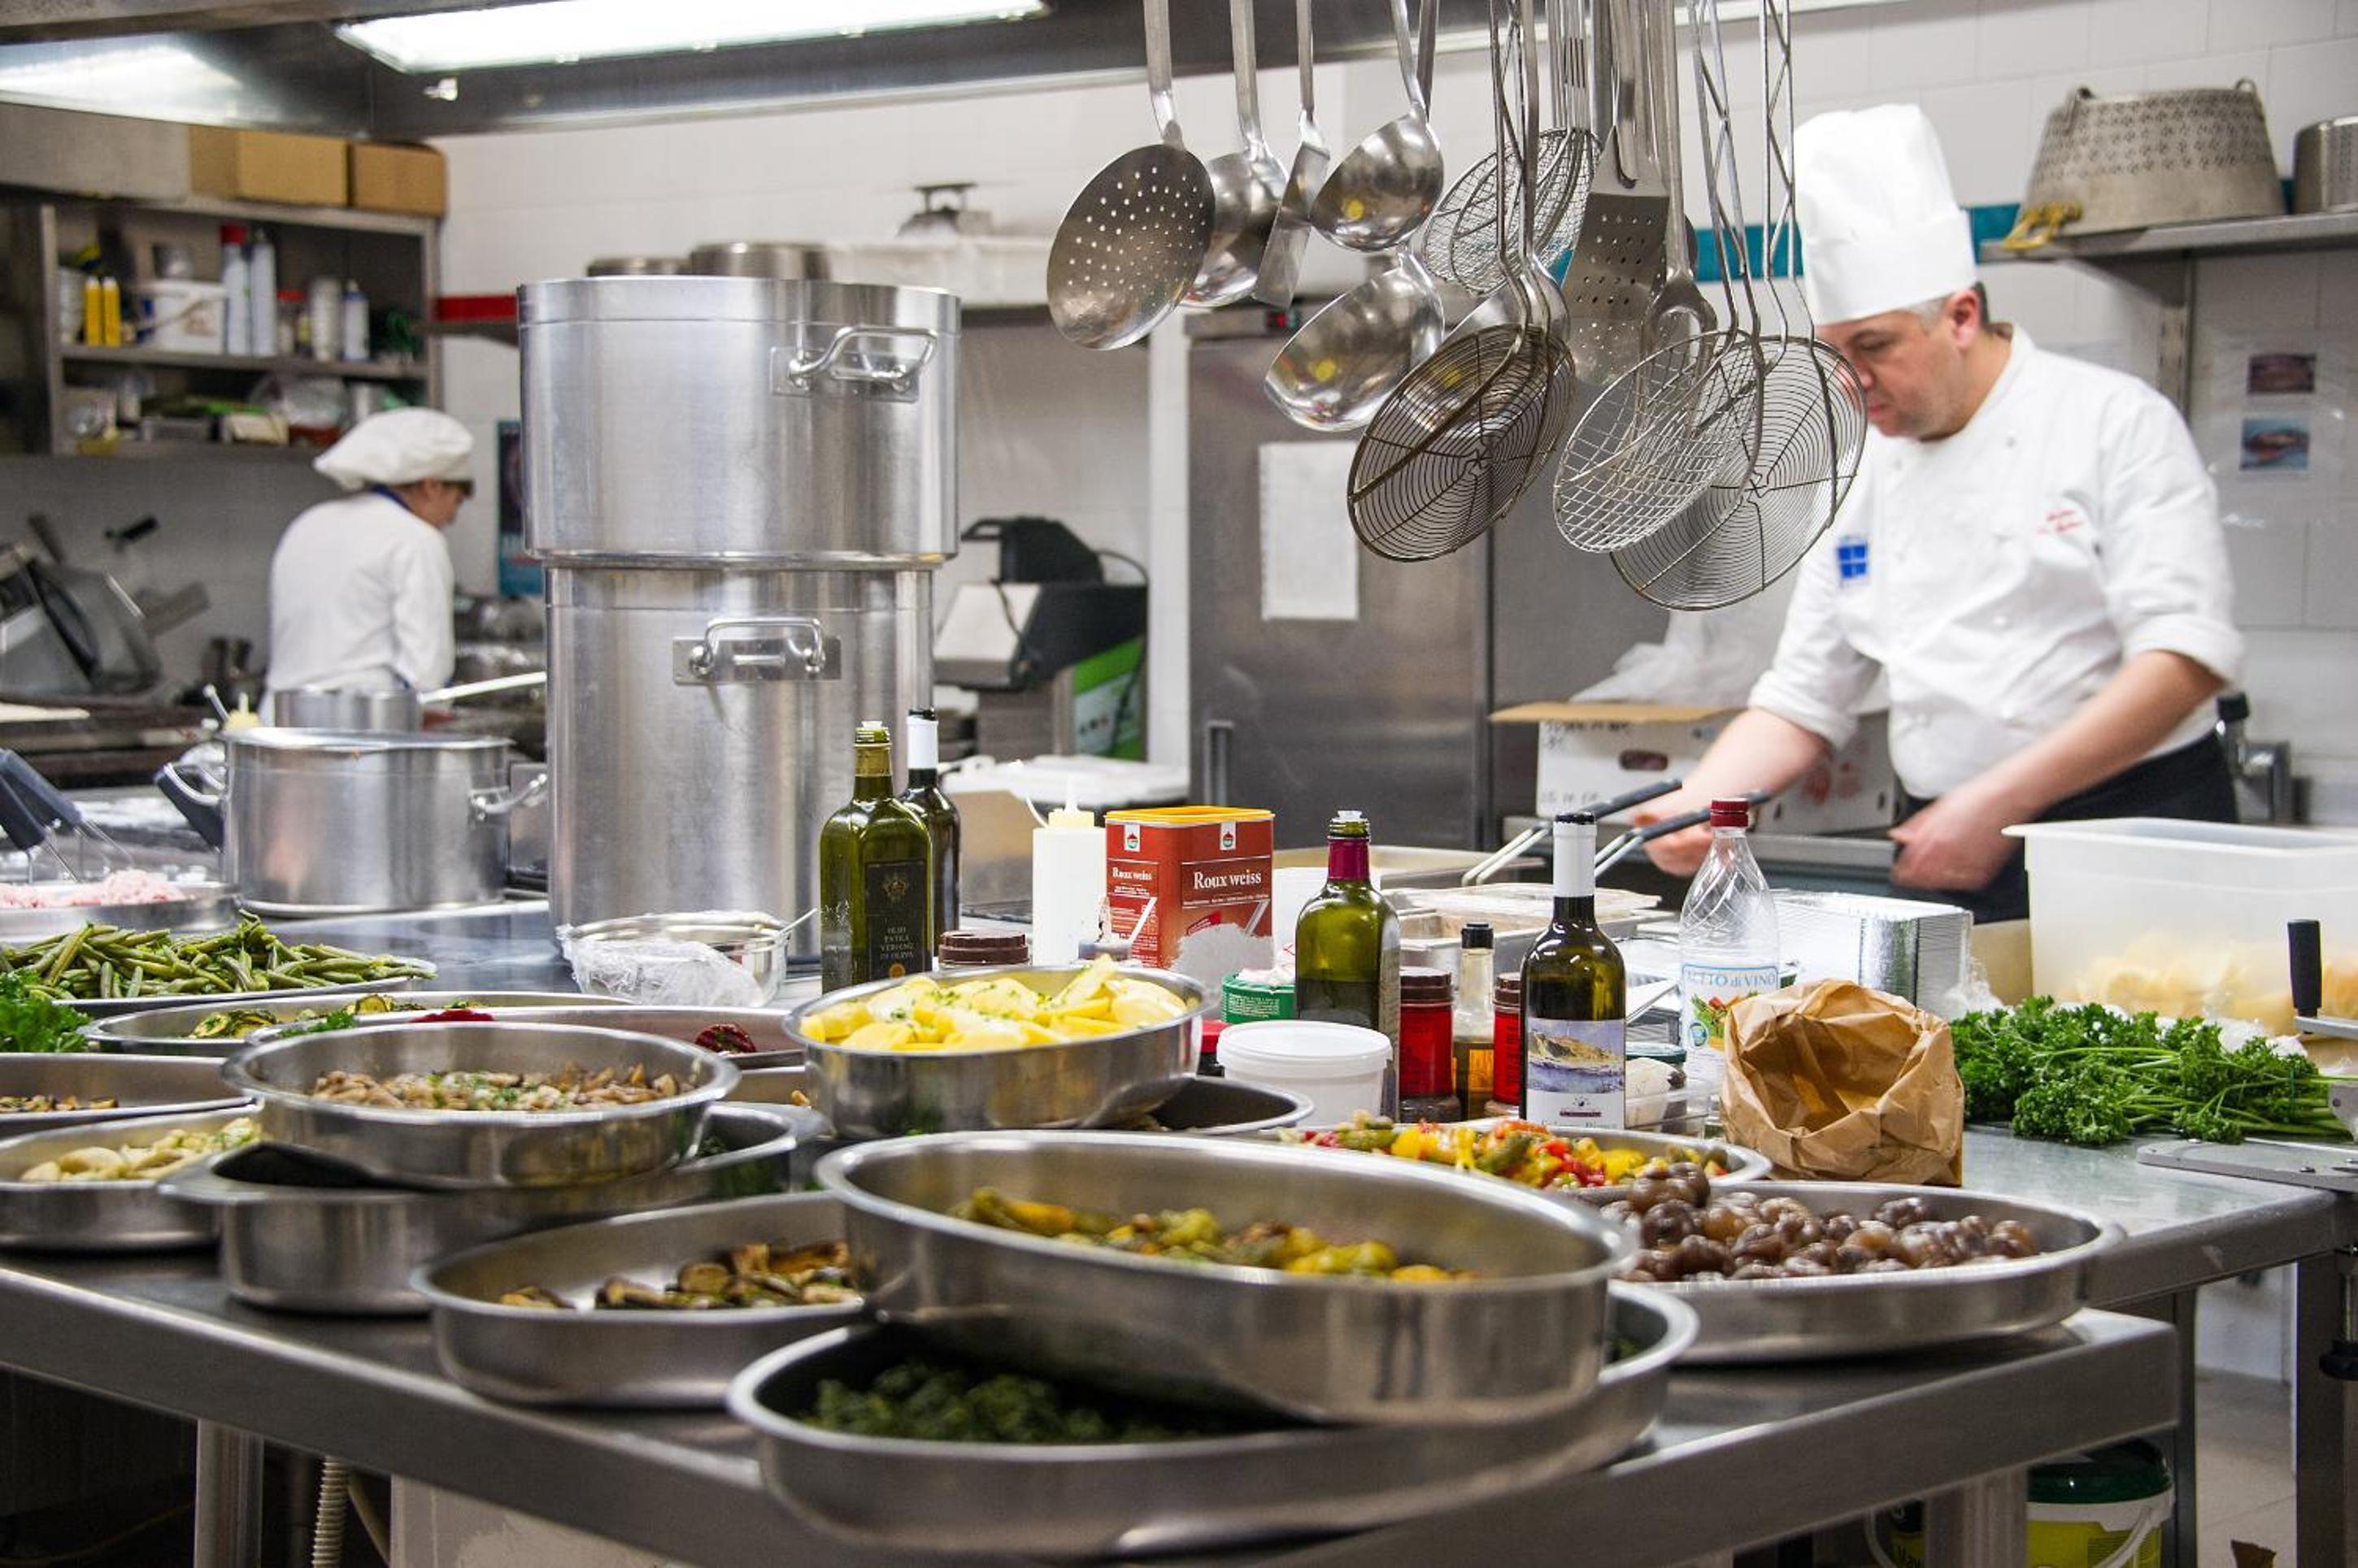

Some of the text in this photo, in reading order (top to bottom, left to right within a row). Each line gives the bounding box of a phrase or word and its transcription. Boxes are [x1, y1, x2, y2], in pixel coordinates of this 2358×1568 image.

[1112, 867, 1152, 880] Roux weiss
[1194, 869, 1262, 889] Roux weiss
[1744, 973, 1776, 986] VINO
